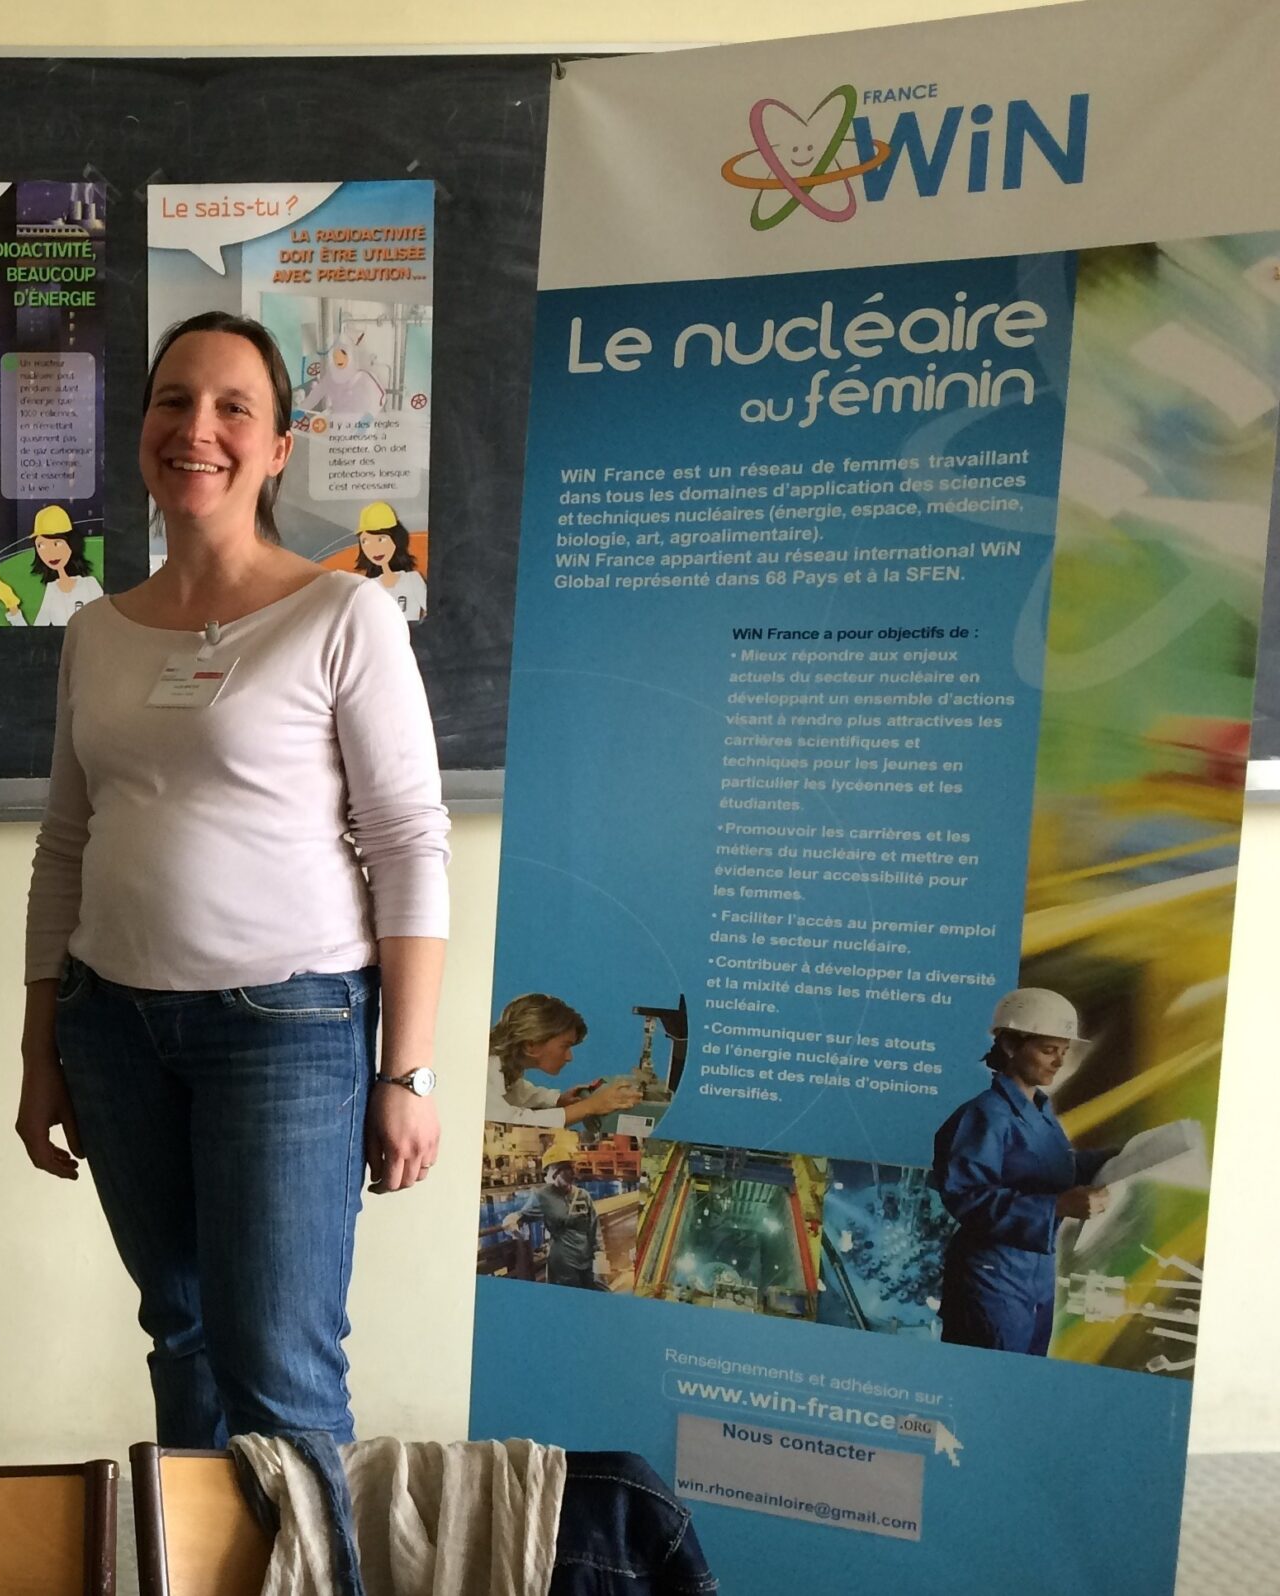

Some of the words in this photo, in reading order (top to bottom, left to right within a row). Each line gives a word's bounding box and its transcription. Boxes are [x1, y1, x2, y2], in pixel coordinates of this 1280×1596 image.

[862, 83, 939, 105] FRANCE
[852, 93, 1089, 203] WiN
[161, 198, 188, 219] Le
[196, 196, 279, 216] sais-tu
[290, 229, 310, 243] LA
[316, 224, 427, 243] RADIOACTIVITÉ
[279, 249, 313, 264] DOIT
[320, 246, 357, 263] ÊTRE
[362, 244, 427, 262] UTILISÉE
[6, 266, 96, 281] BEAUCOUP
[273, 270, 311, 283] AVEC
[14, 289, 95, 306] D'ÉNERGIE
[568, 317, 652, 373] Le
[673, 291, 1047, 368] nucléaire
[740, 397, 793, 422] au
[798, 359, 1034, 428] féminin
[560, 468, 596, 483] WiN
[604, 467, 665, 481] France
[672, 465, 701, 479] est
[709, 466, 731, 478] un
[740, 462, 803, 476] réseau
[811, 459, 835, 474] de
[842, 457, 919, 472] femmes
[929, 449, 1029, 467] travaillant
[556, 531, 630, 549] biologie,
[635, 531, 663, 545] art,
[669, 526, 823, 547] agroalimentaire).
[732, 628, 763, 640] WiN
[767, 627, 820, 639] France
[823, 630, 832, 639] a
[836, 630, 873, 642] pour
[877, 625, 944, 641] objectifs
[949, 625, 969, 638] de
[721, 910, 783, 924] Faciliter
[787, 914, 842, 928] l'accès
[847, 919, 866, 929] au
[871, 920, 934, 933] premier
[939, 924, 995, 938] emploi
[705, 998, 779, 1012] nucléaire.
[665, 1347, 804, 1384] Renseignements
[808, 1374, 826, 1386] et
[830, 1378, 910, 1400] adhésion
[915, 1391, 944, 1405] sur
[723, 1422, 772, 1445] Nous
[780, 1436, 875, 1462] contacter
[677, 1478, 916, 1531] win.rhoneainloire@gmail.com
